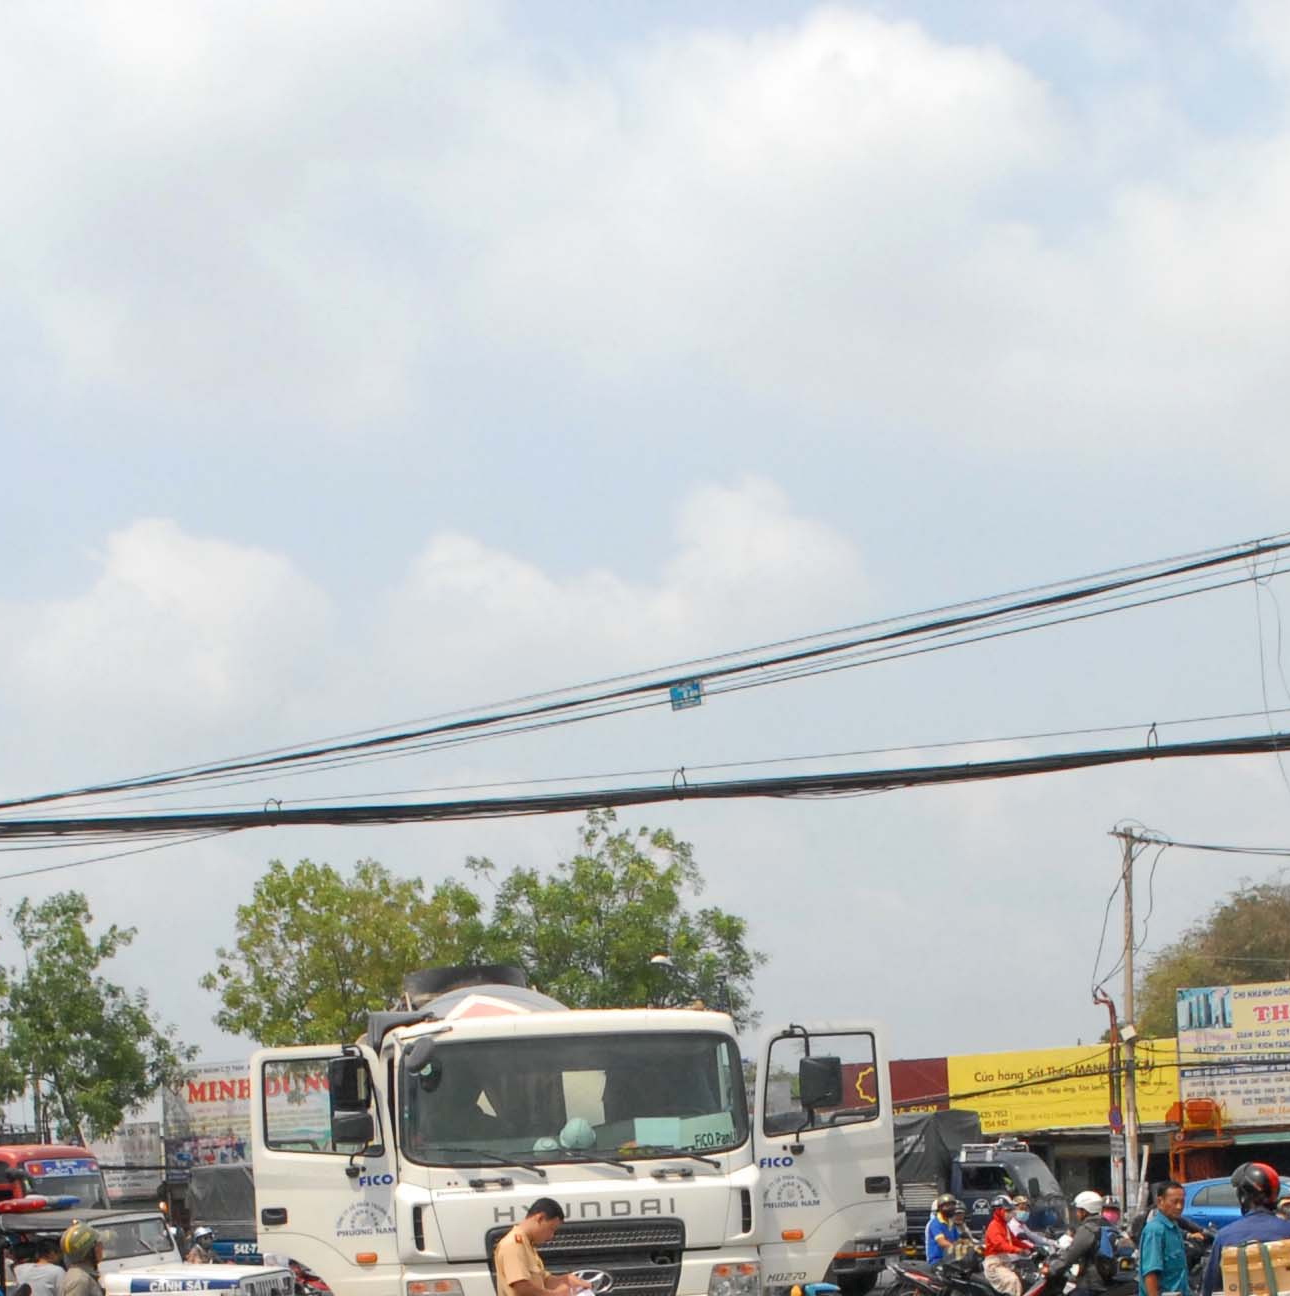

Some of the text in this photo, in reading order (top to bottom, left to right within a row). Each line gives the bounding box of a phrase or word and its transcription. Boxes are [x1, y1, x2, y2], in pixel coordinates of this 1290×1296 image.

[187, 1078, 251, 1104] MINH
[759, 1156, 794, 1169] FICO
[359, 1173, 394, 1188] FICO
